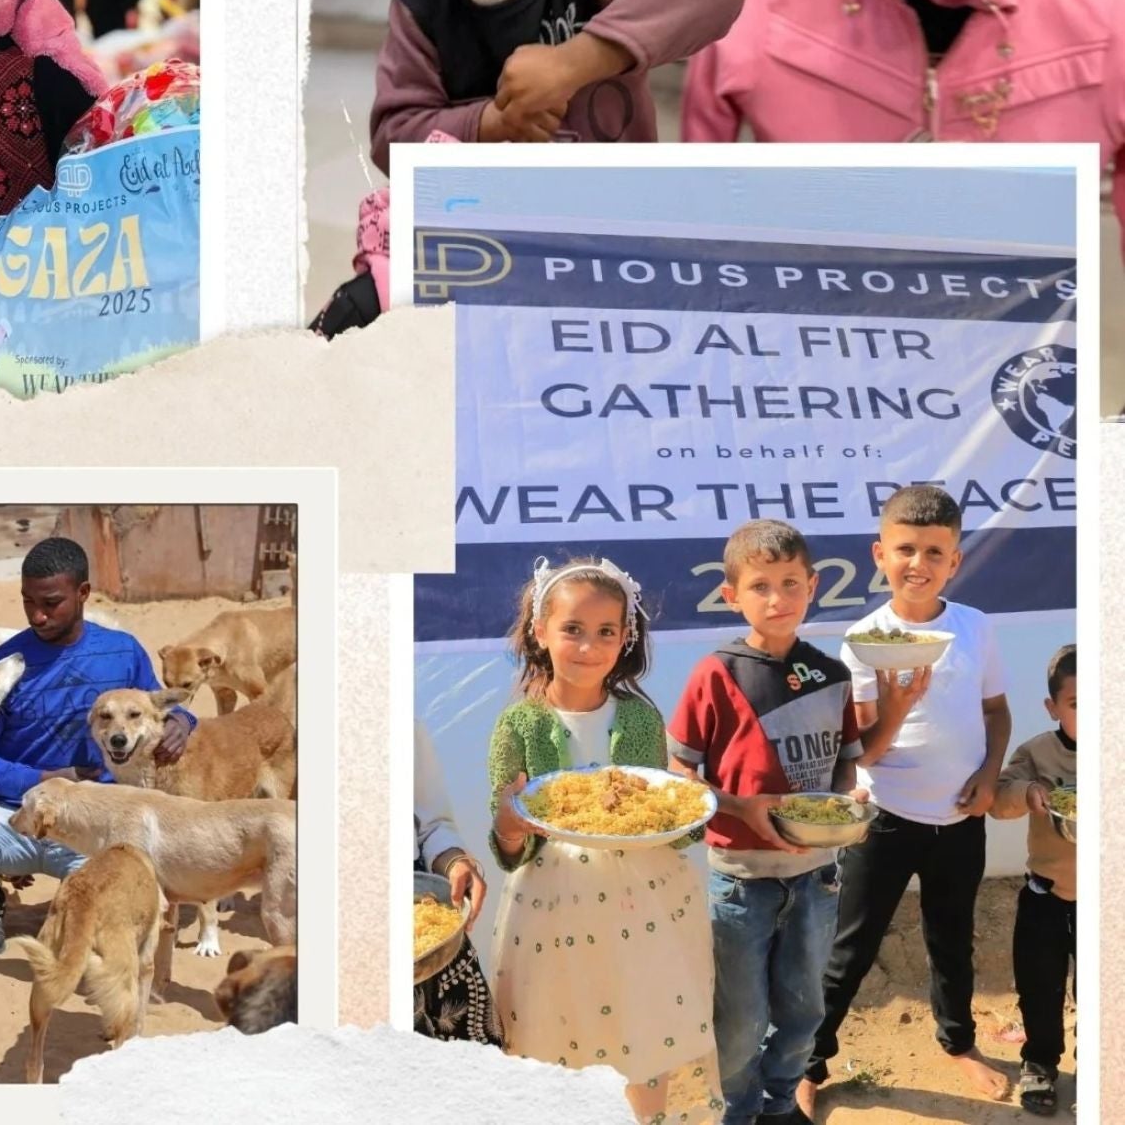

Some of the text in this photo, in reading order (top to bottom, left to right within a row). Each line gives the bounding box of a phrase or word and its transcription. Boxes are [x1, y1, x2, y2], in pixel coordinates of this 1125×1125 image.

[120, 154, 152, 195] Eid
[154, 153, 171, 179] al
[65, 194, 127, 214] PROJECTS
[544, 257, 1077, 300] PIOUS PROJECTS
[99, 288, 152, 317] 2025
[551, 319, 936, 361] EID AL FITR
[997, 347, 1057, 393] WEAR
[540, 383, 962, 420] GATHERING
[656, 442, 883, 460] on behalf of:
[455, 477, 1077, 525] WEAR THE PACE
